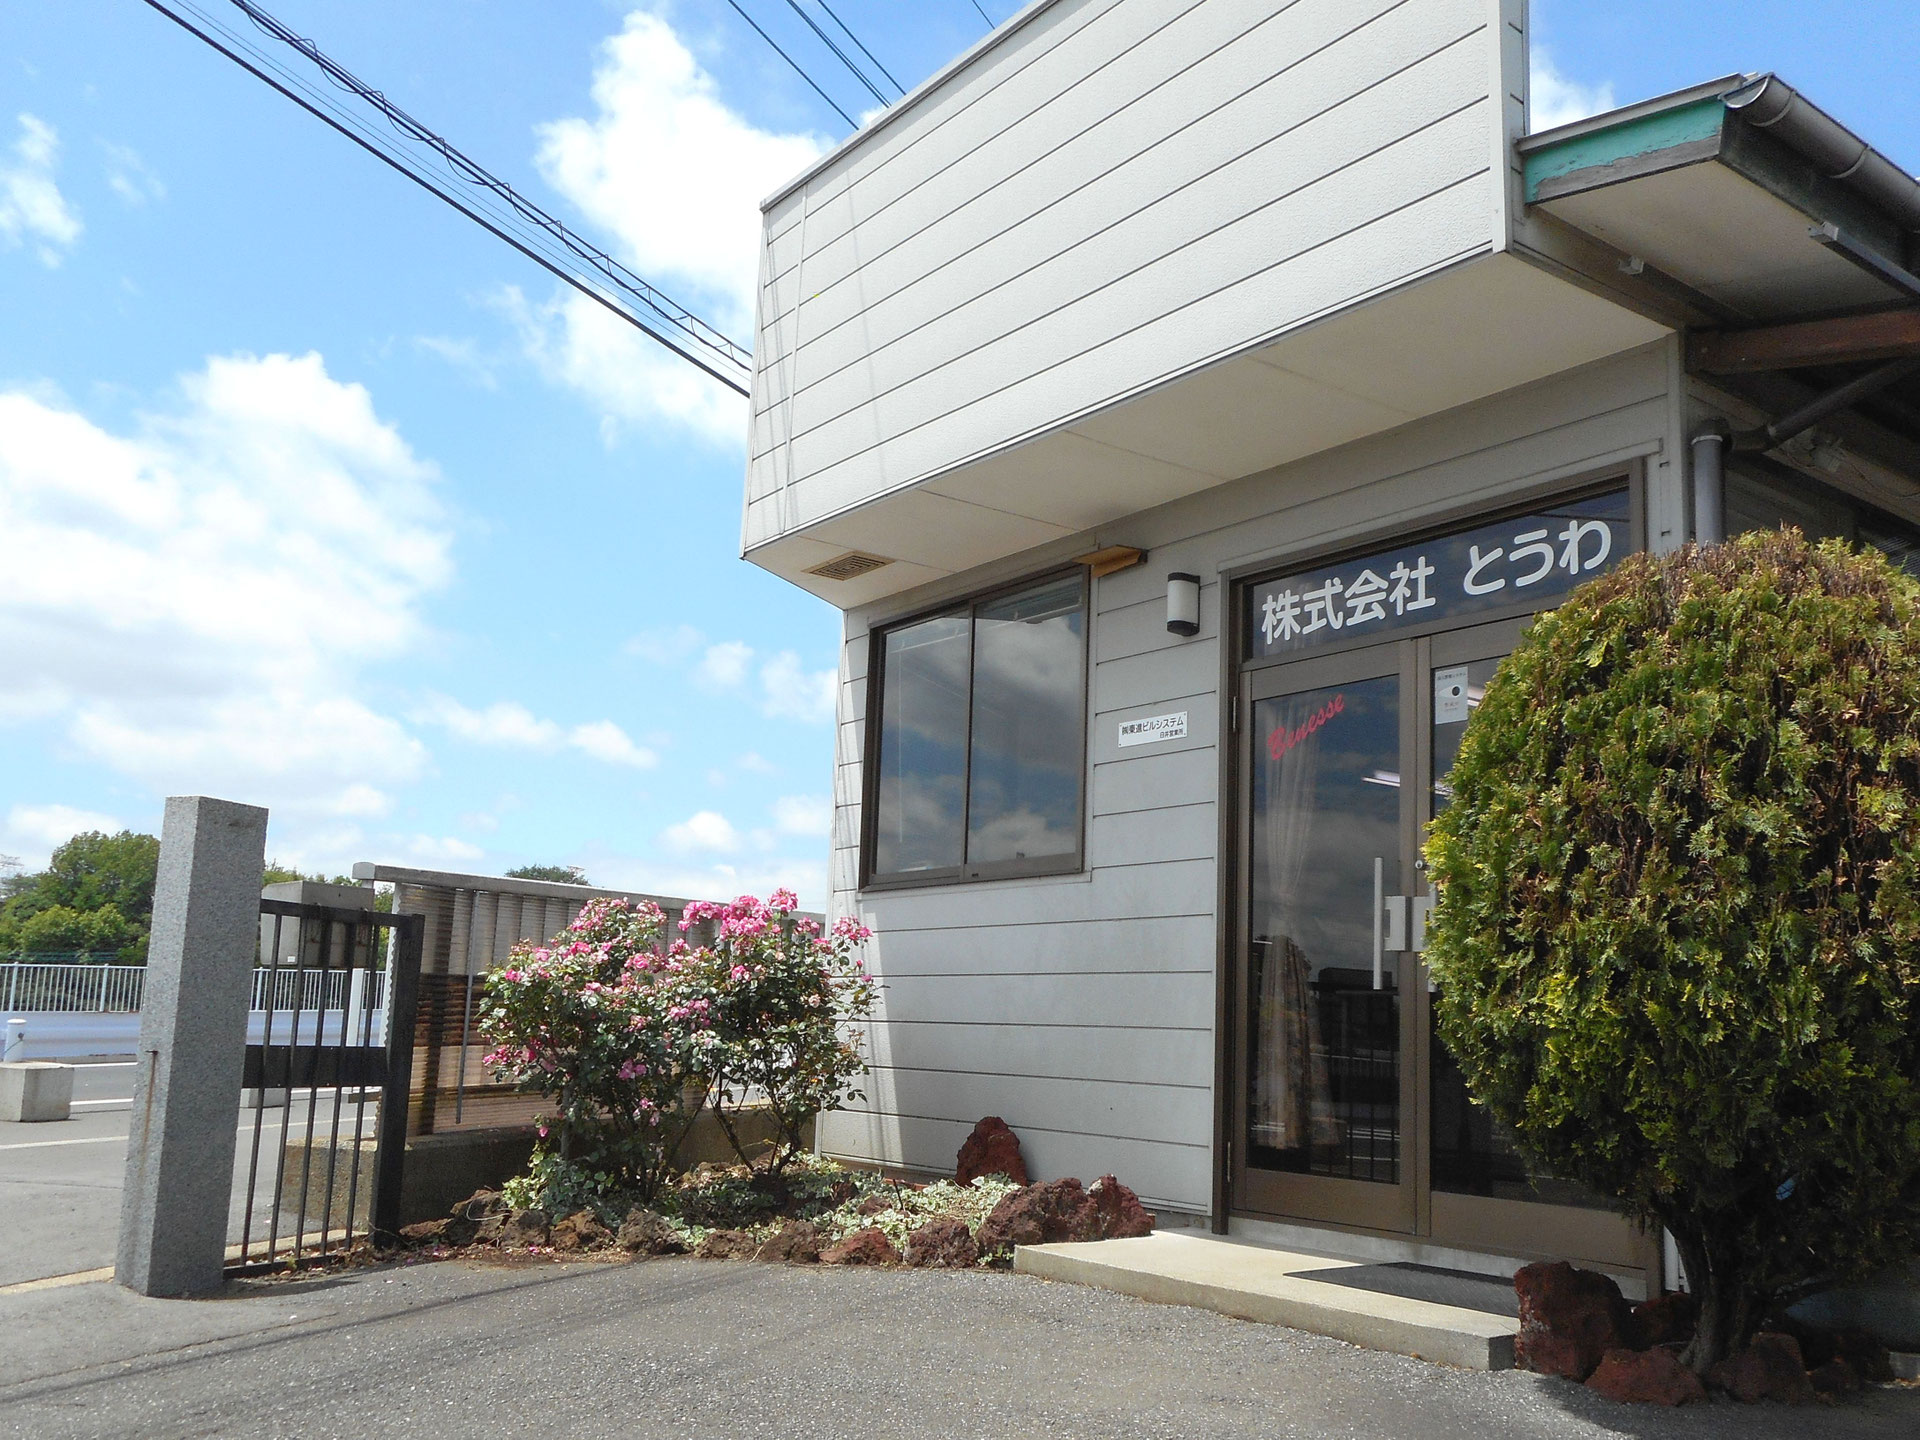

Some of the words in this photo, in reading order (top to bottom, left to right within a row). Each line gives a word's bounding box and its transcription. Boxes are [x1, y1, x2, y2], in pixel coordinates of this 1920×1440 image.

[1261, 557, 1436, 644] 株式会社
[1463, 520, 1612, 595] とうわ
[1267, 693, 1345, 760] Benesse
